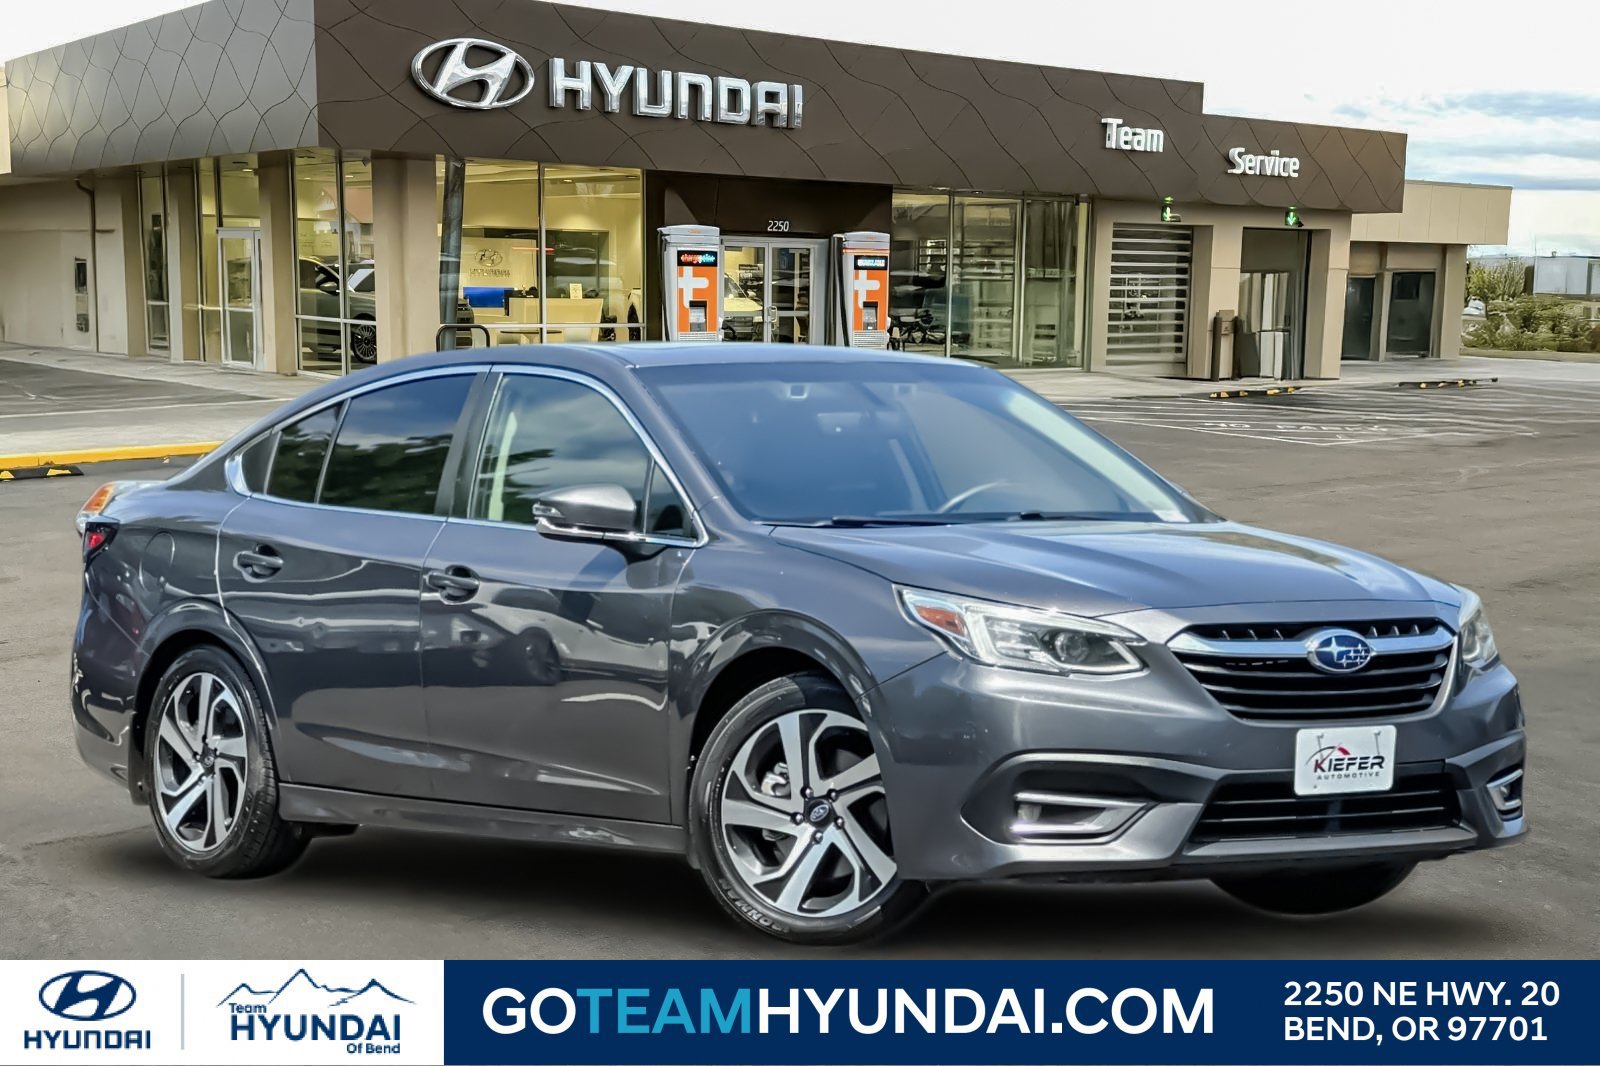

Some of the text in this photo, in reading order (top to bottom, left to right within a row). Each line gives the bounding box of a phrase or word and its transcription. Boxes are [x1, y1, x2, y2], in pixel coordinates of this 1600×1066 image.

[549, 57, 803, 129] HYUNDAI
[1101, 117, 1164, 152] Team
[1227, 147, 1300, 178] Service
[767, 220, 790, 232] 2250
[1313, 755, 1385, 774] KIEFER
[1316, 771, 1380, 780] AUTOMOTIVE
